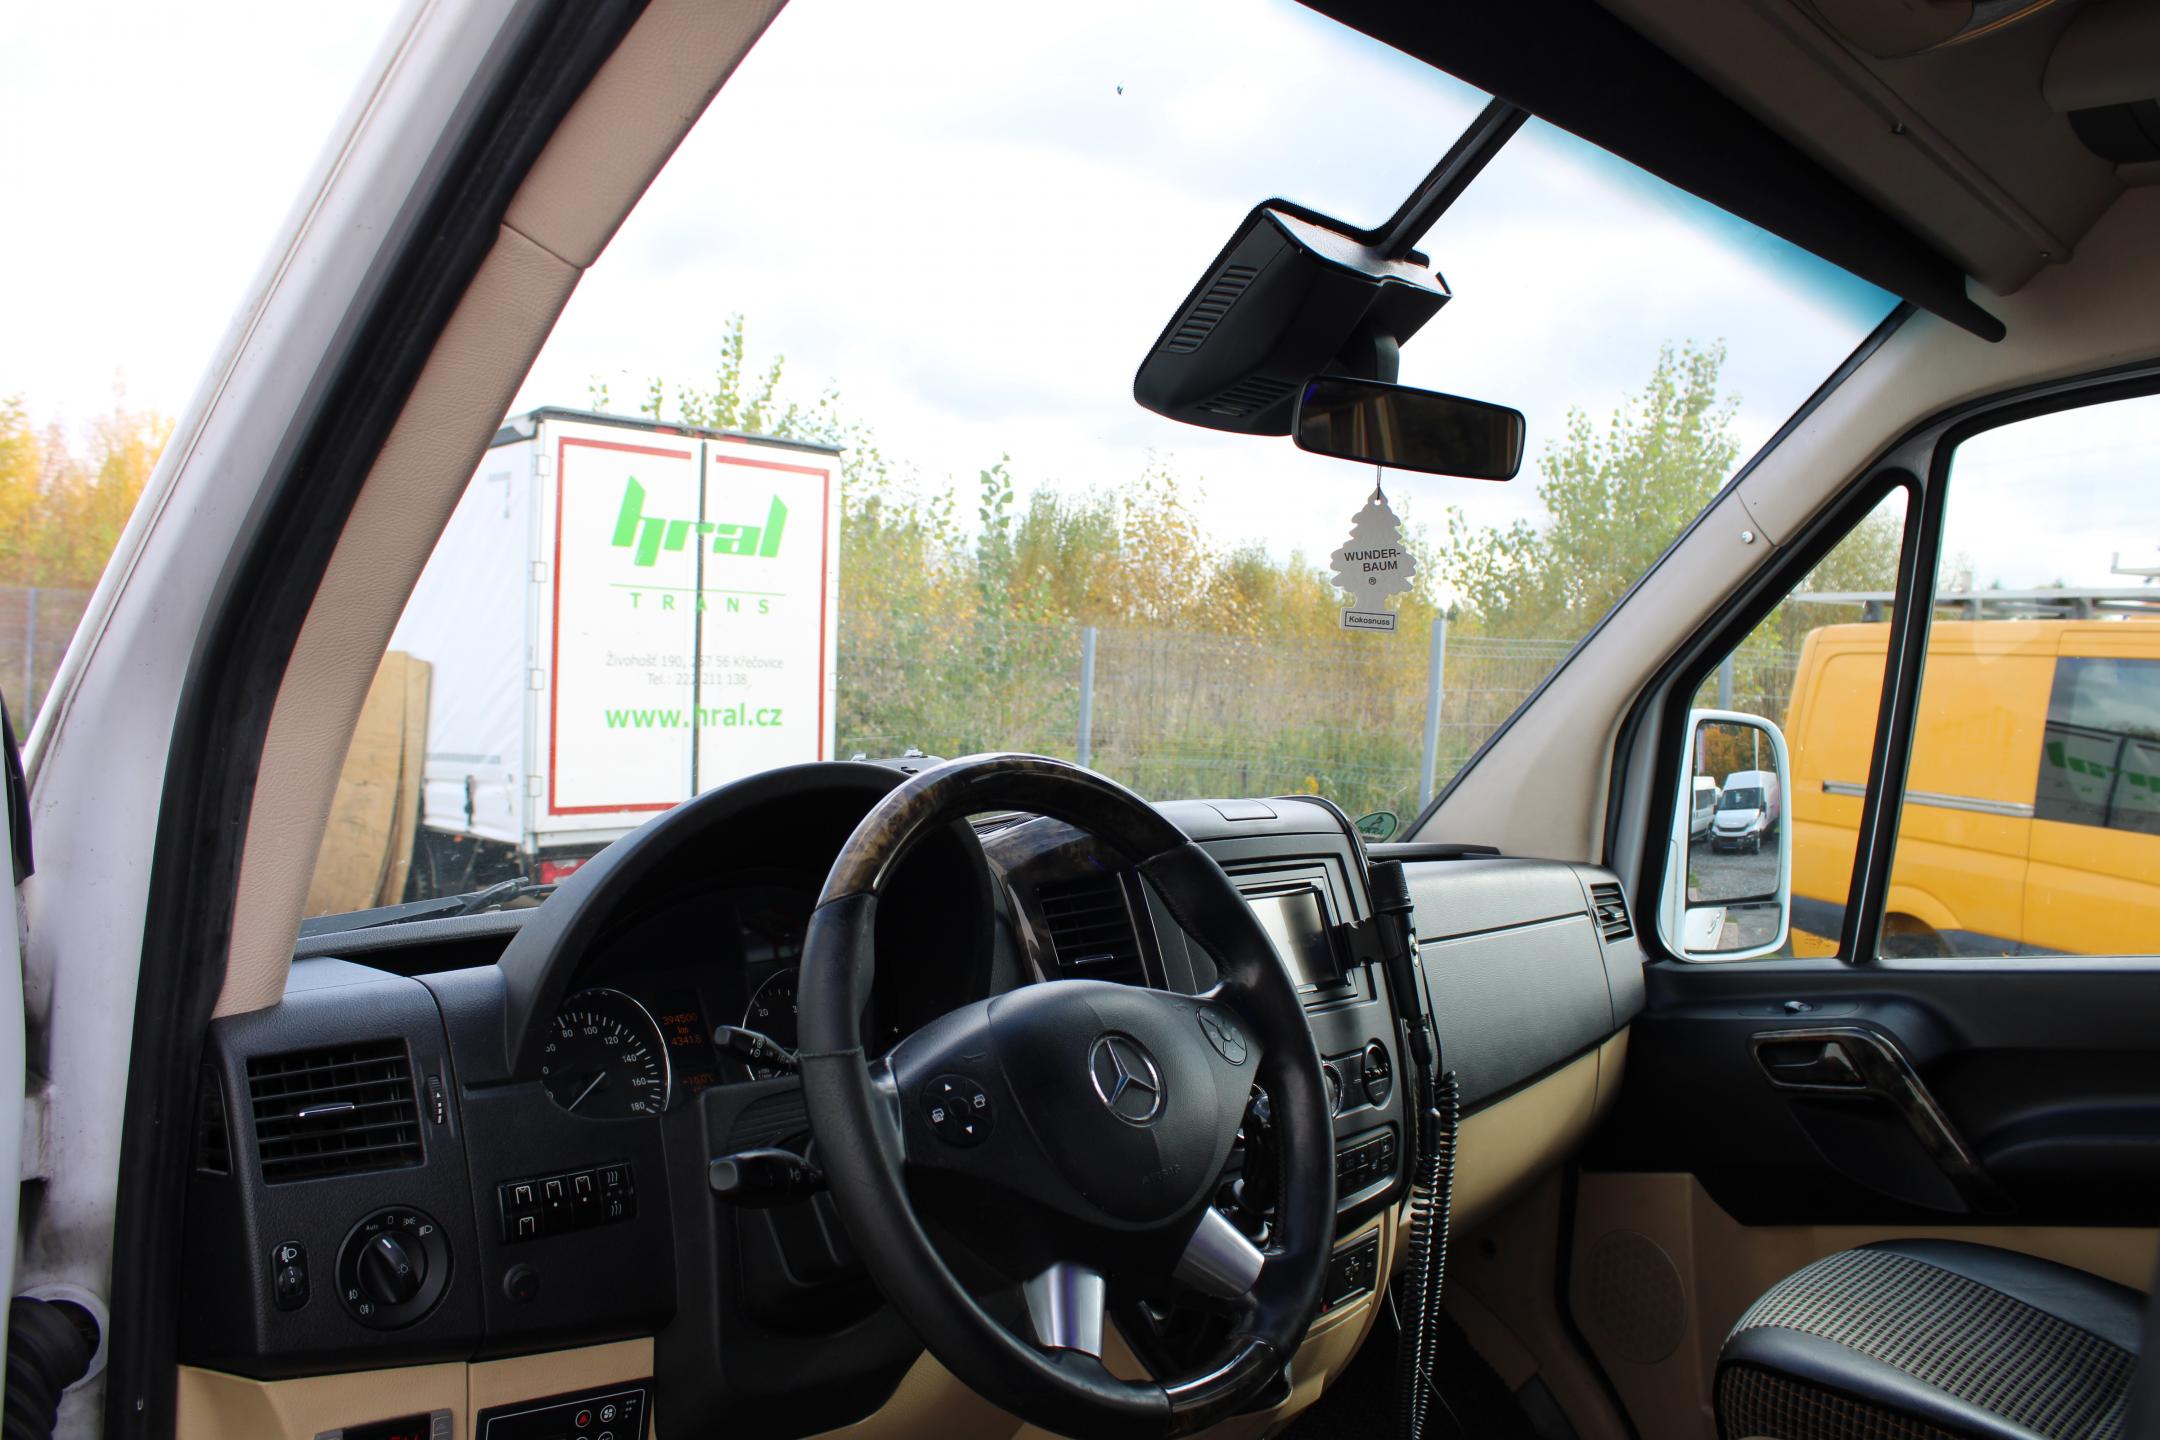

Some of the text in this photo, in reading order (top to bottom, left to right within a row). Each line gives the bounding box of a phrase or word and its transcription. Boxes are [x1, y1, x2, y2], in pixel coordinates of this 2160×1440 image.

[611, 475, 788, 567] hral
[1344, 549, 1401, 562] WUNDER-
[1363, 561, 1398, 572] BAUM
[630, 592, 769, 615] TRANS
[1348, 615, 1391, 626] Kokosnuss
[715, 656, 730, 668] 56
[605, 702, 783, 729] www.hral.cz
[758, 1008, 769, 1017] 20
[562, 1029, 574, 1039] 80
[583, 1026, 598, 1036] 100
[604, 1036, 619, 1045] 120
[622, 1054, 637, 1063] 140
[631, 1077, 646, 1087] 160
[630, 1101, 645, 1111] 180
